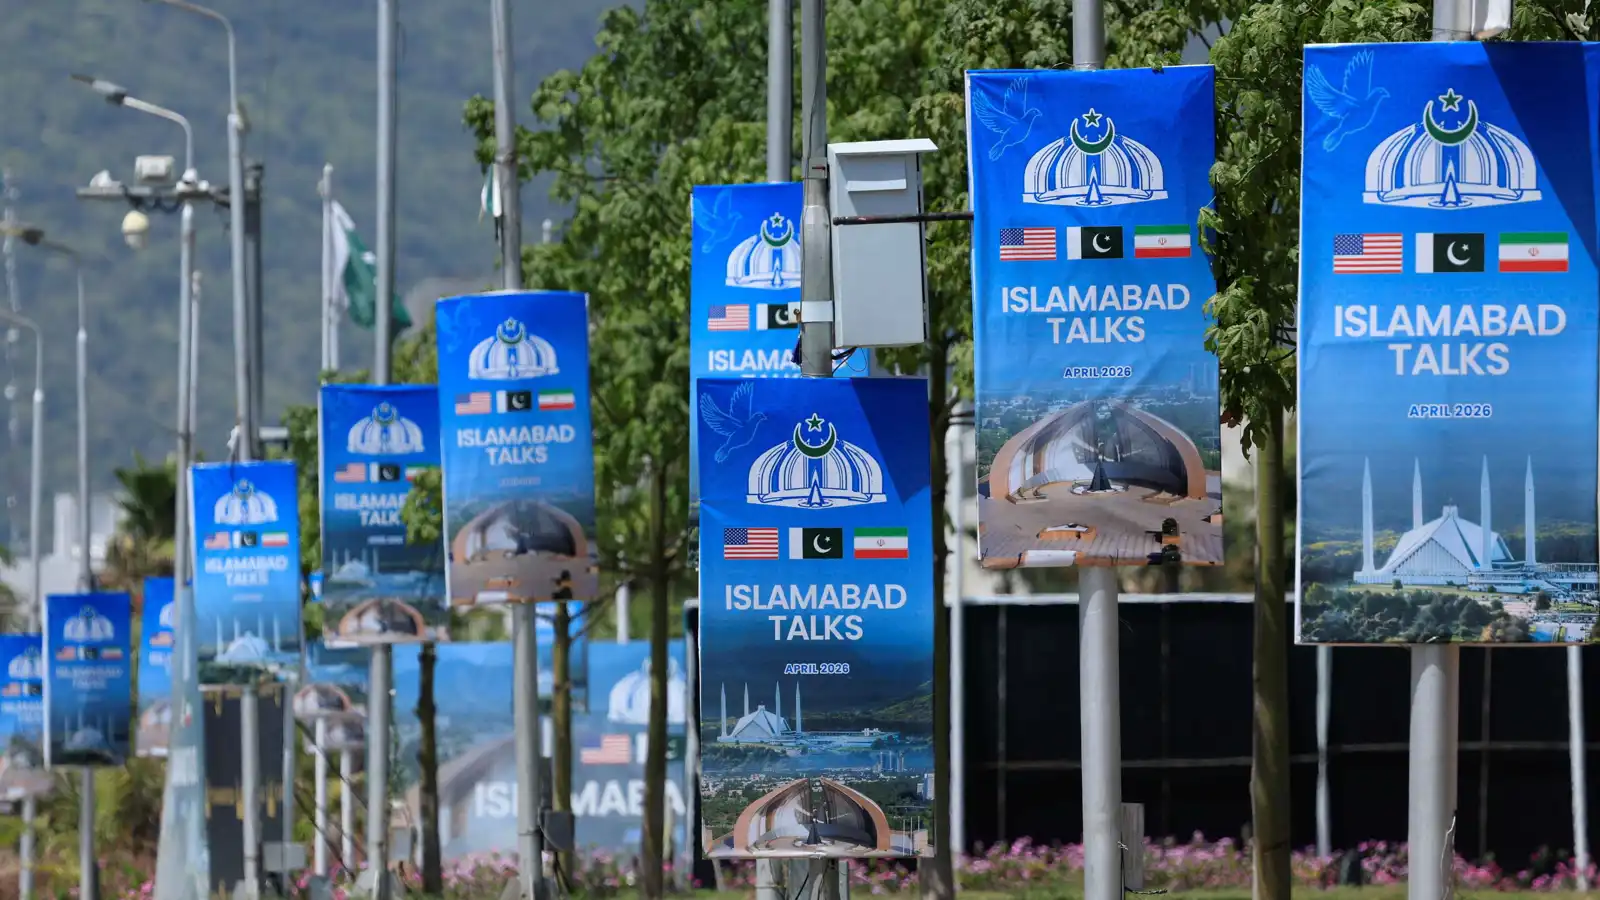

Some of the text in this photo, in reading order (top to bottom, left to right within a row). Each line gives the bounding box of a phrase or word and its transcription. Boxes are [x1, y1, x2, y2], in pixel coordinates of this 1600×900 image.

[1001, 283, 1191, 313] ISLAMABAD
[1046, 316, 1146, 344] TALKS
[1334, 304, 1567, 337] ISLAMABAD
[1388, 343, 1510, 376] TALKS
[1062, 366, 1132, 379] APRIL 2026
[1408, 404, 1493, 418] APRIL 2026
[457, 424, 576, 448] ISLAMABAD
[486, 446, 548, 466] TALKS
[359, 510, 402, 527] TALK
[725, 584, 907, 610] ISLAMABAD
[768, 615, 864, 641] TALKS
[784, 663, 850, 675] APRIL 2026
